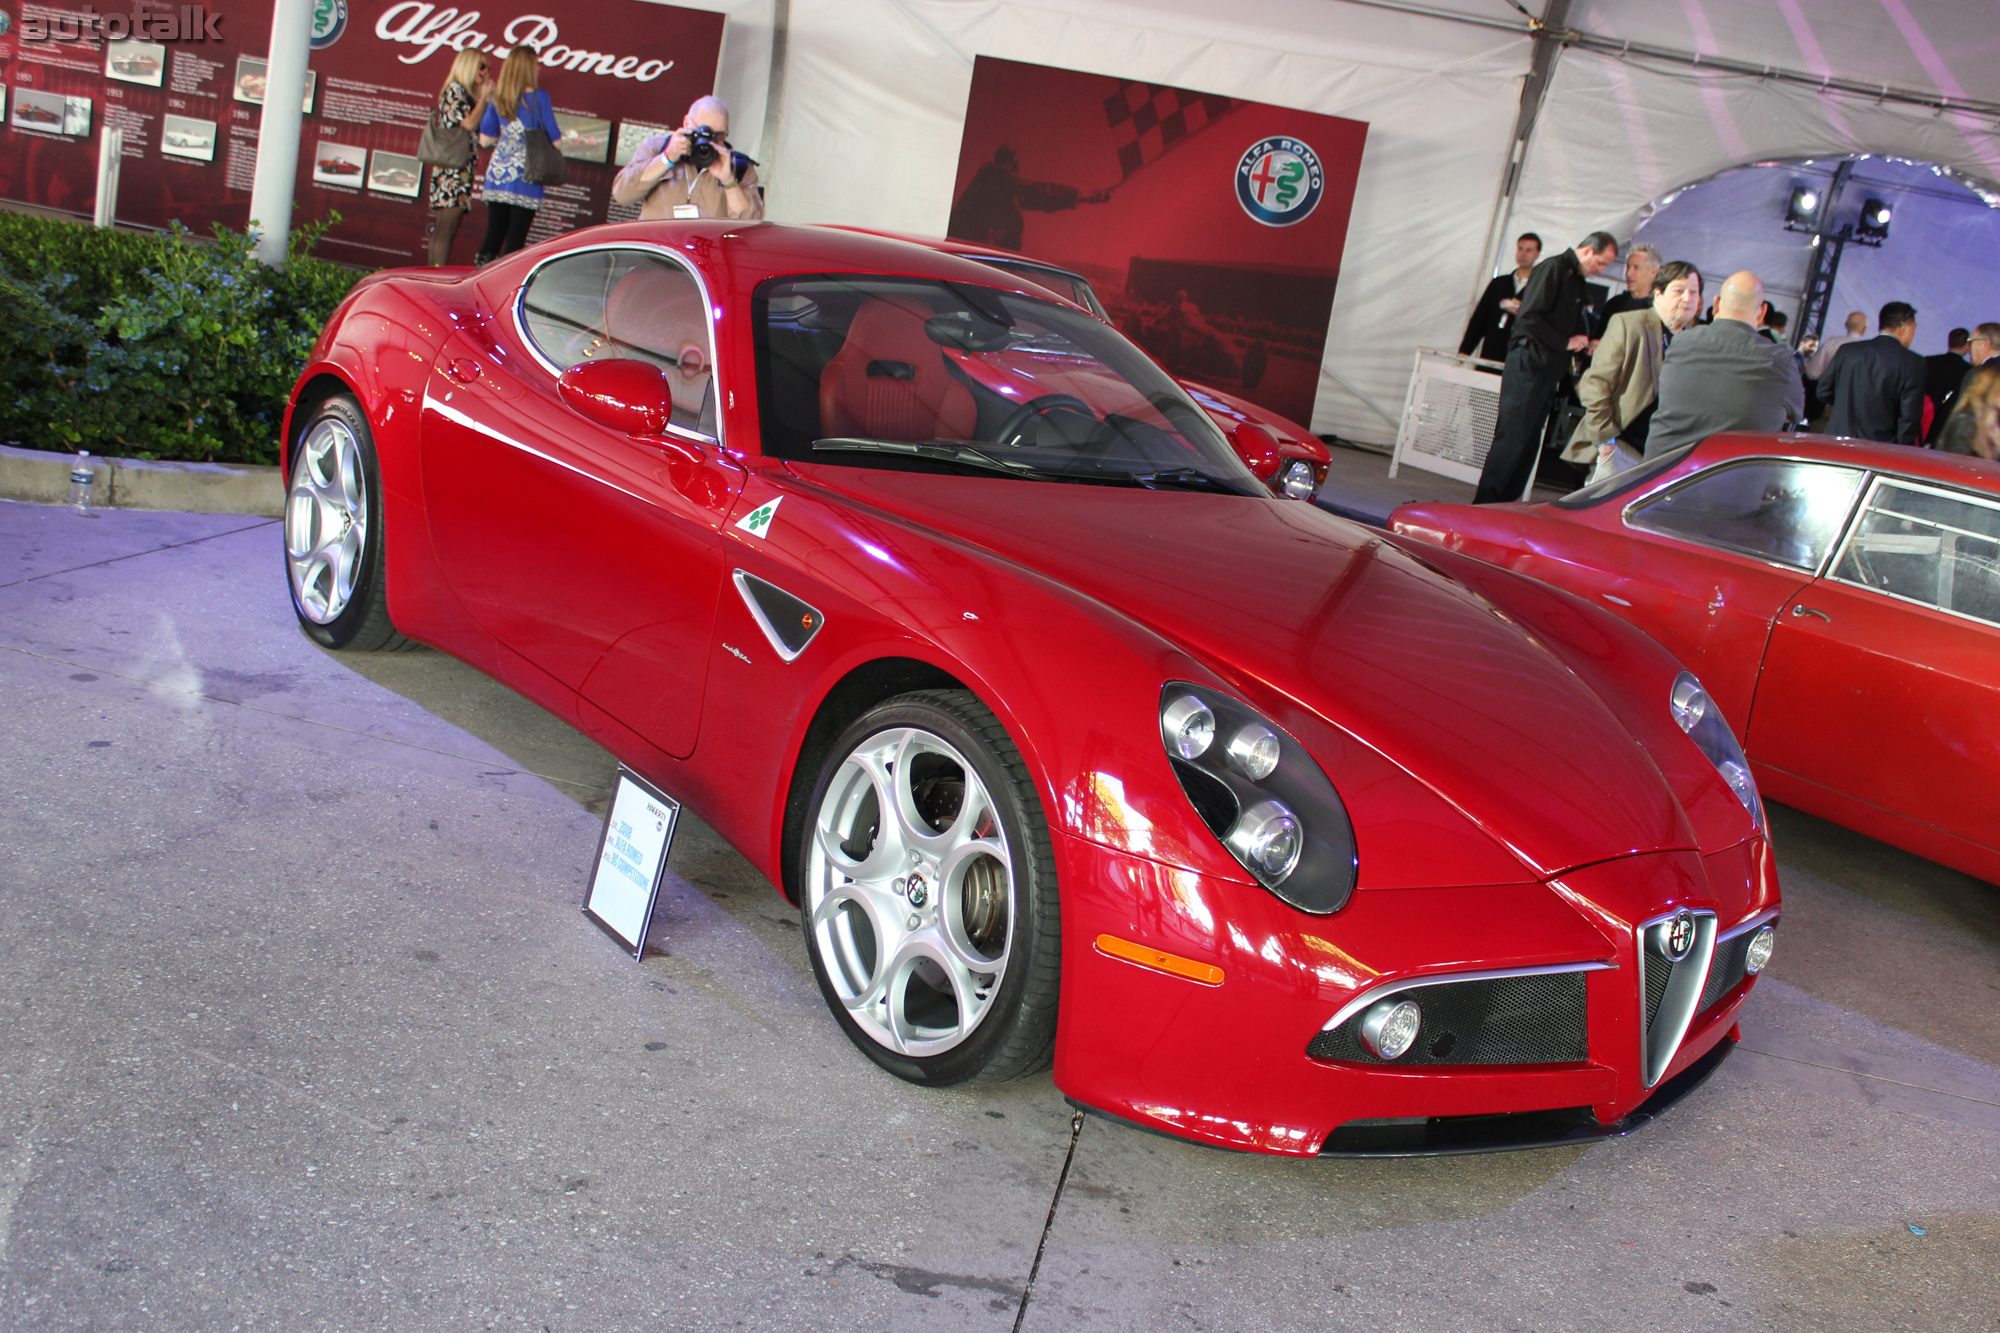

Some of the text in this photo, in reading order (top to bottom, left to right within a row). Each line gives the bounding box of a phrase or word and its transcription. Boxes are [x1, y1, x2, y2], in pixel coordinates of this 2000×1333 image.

[375, 1, 674, 82] Alfa Romeo
[16, 71, 33, 83] 1950
[106, 88, 124, 99] 1953
[168, 98, 186, 109] 1962
[232, 109, 250, 120] 1965
[319, 125, 337, 136] 1967
[1240, 139, 1320, 190] ALFA ROMEO
[647, 802, 666, 820] HAGERTY
[615, 836, 627, 853] ALFA
[627, 844, 643, 866] ROMEO
[618, 857, 649, 890] COMPETIZIONE
